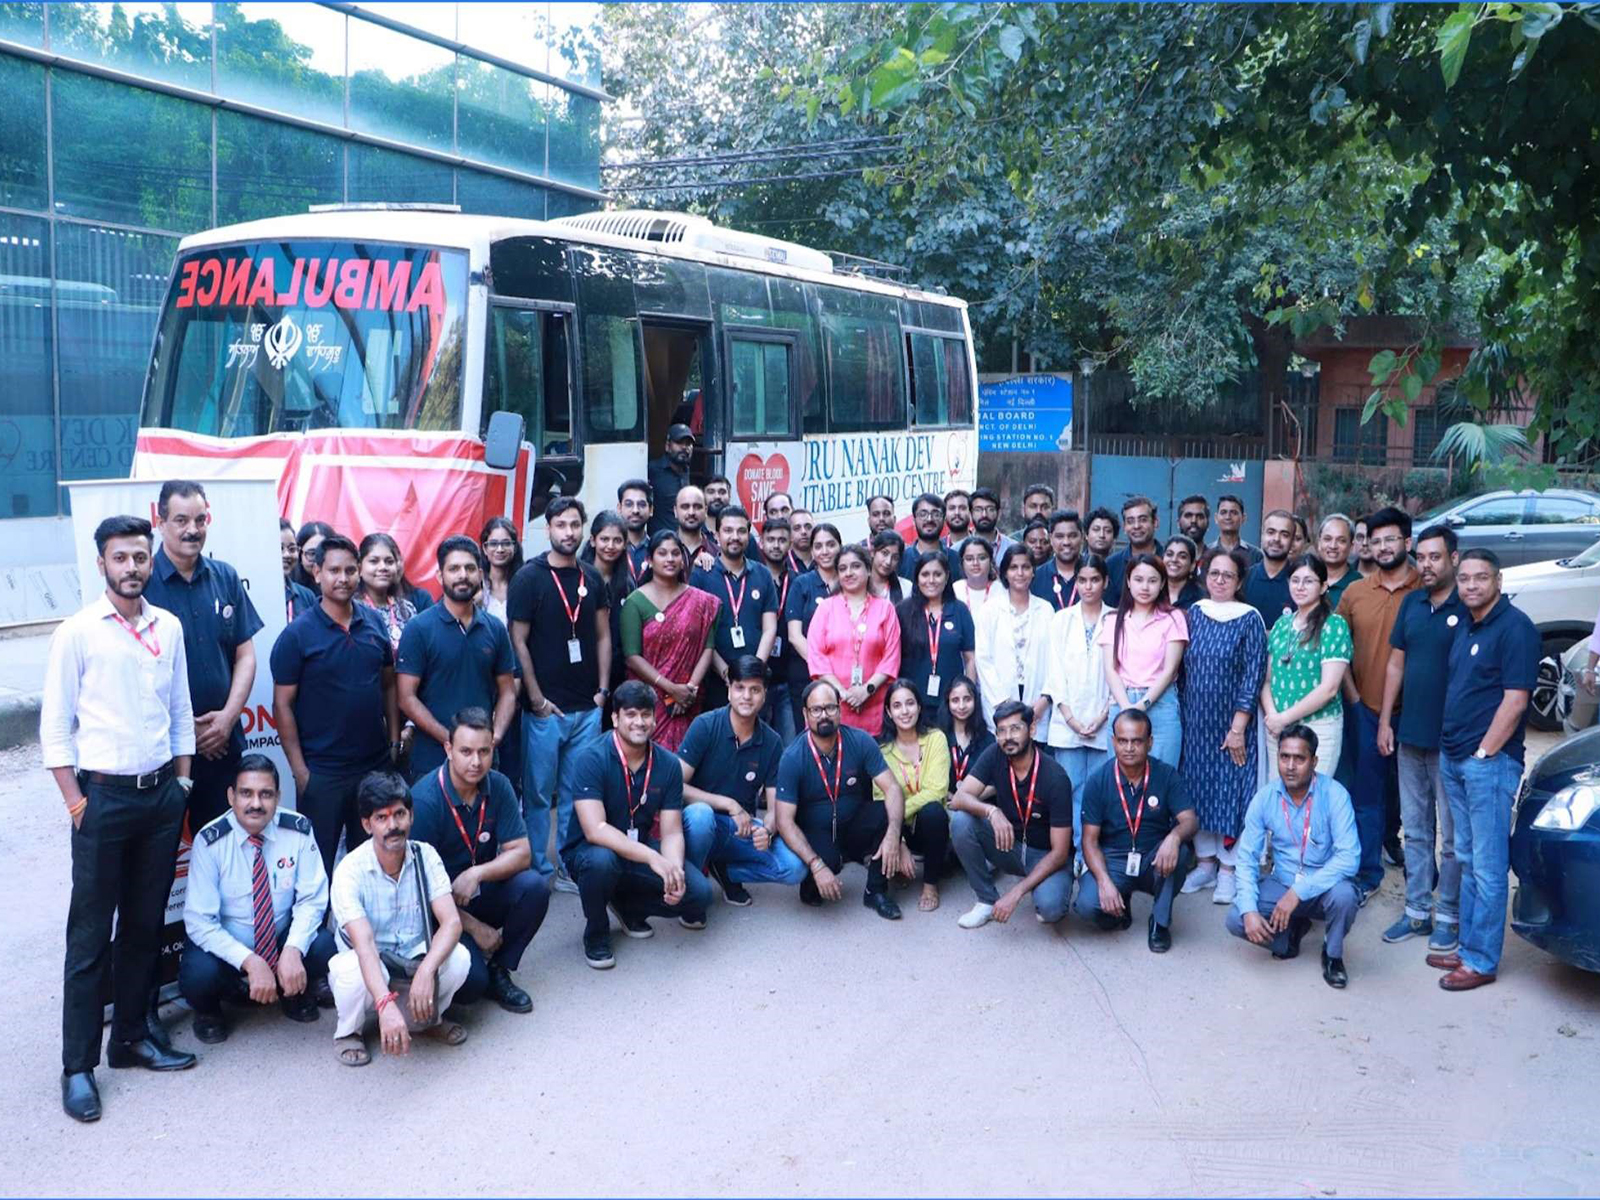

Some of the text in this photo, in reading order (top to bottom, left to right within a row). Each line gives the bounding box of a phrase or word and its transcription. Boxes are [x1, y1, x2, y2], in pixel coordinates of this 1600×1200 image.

[997, 411, 1035, 420] BOARD
[1012, 423, 1037, 431] DELHI
[996, 433, 1031, 441] STATION
[991, 441, 1037, 449] NEW DELHI
[841, 436, 901, 478] NANAK
[905, 434, 935, 474] DEV
[744, 468, 765, 480] DONATE
[855, 475, 900, 508] BLOOD
[902, 470, 946, 500] CENTRE
